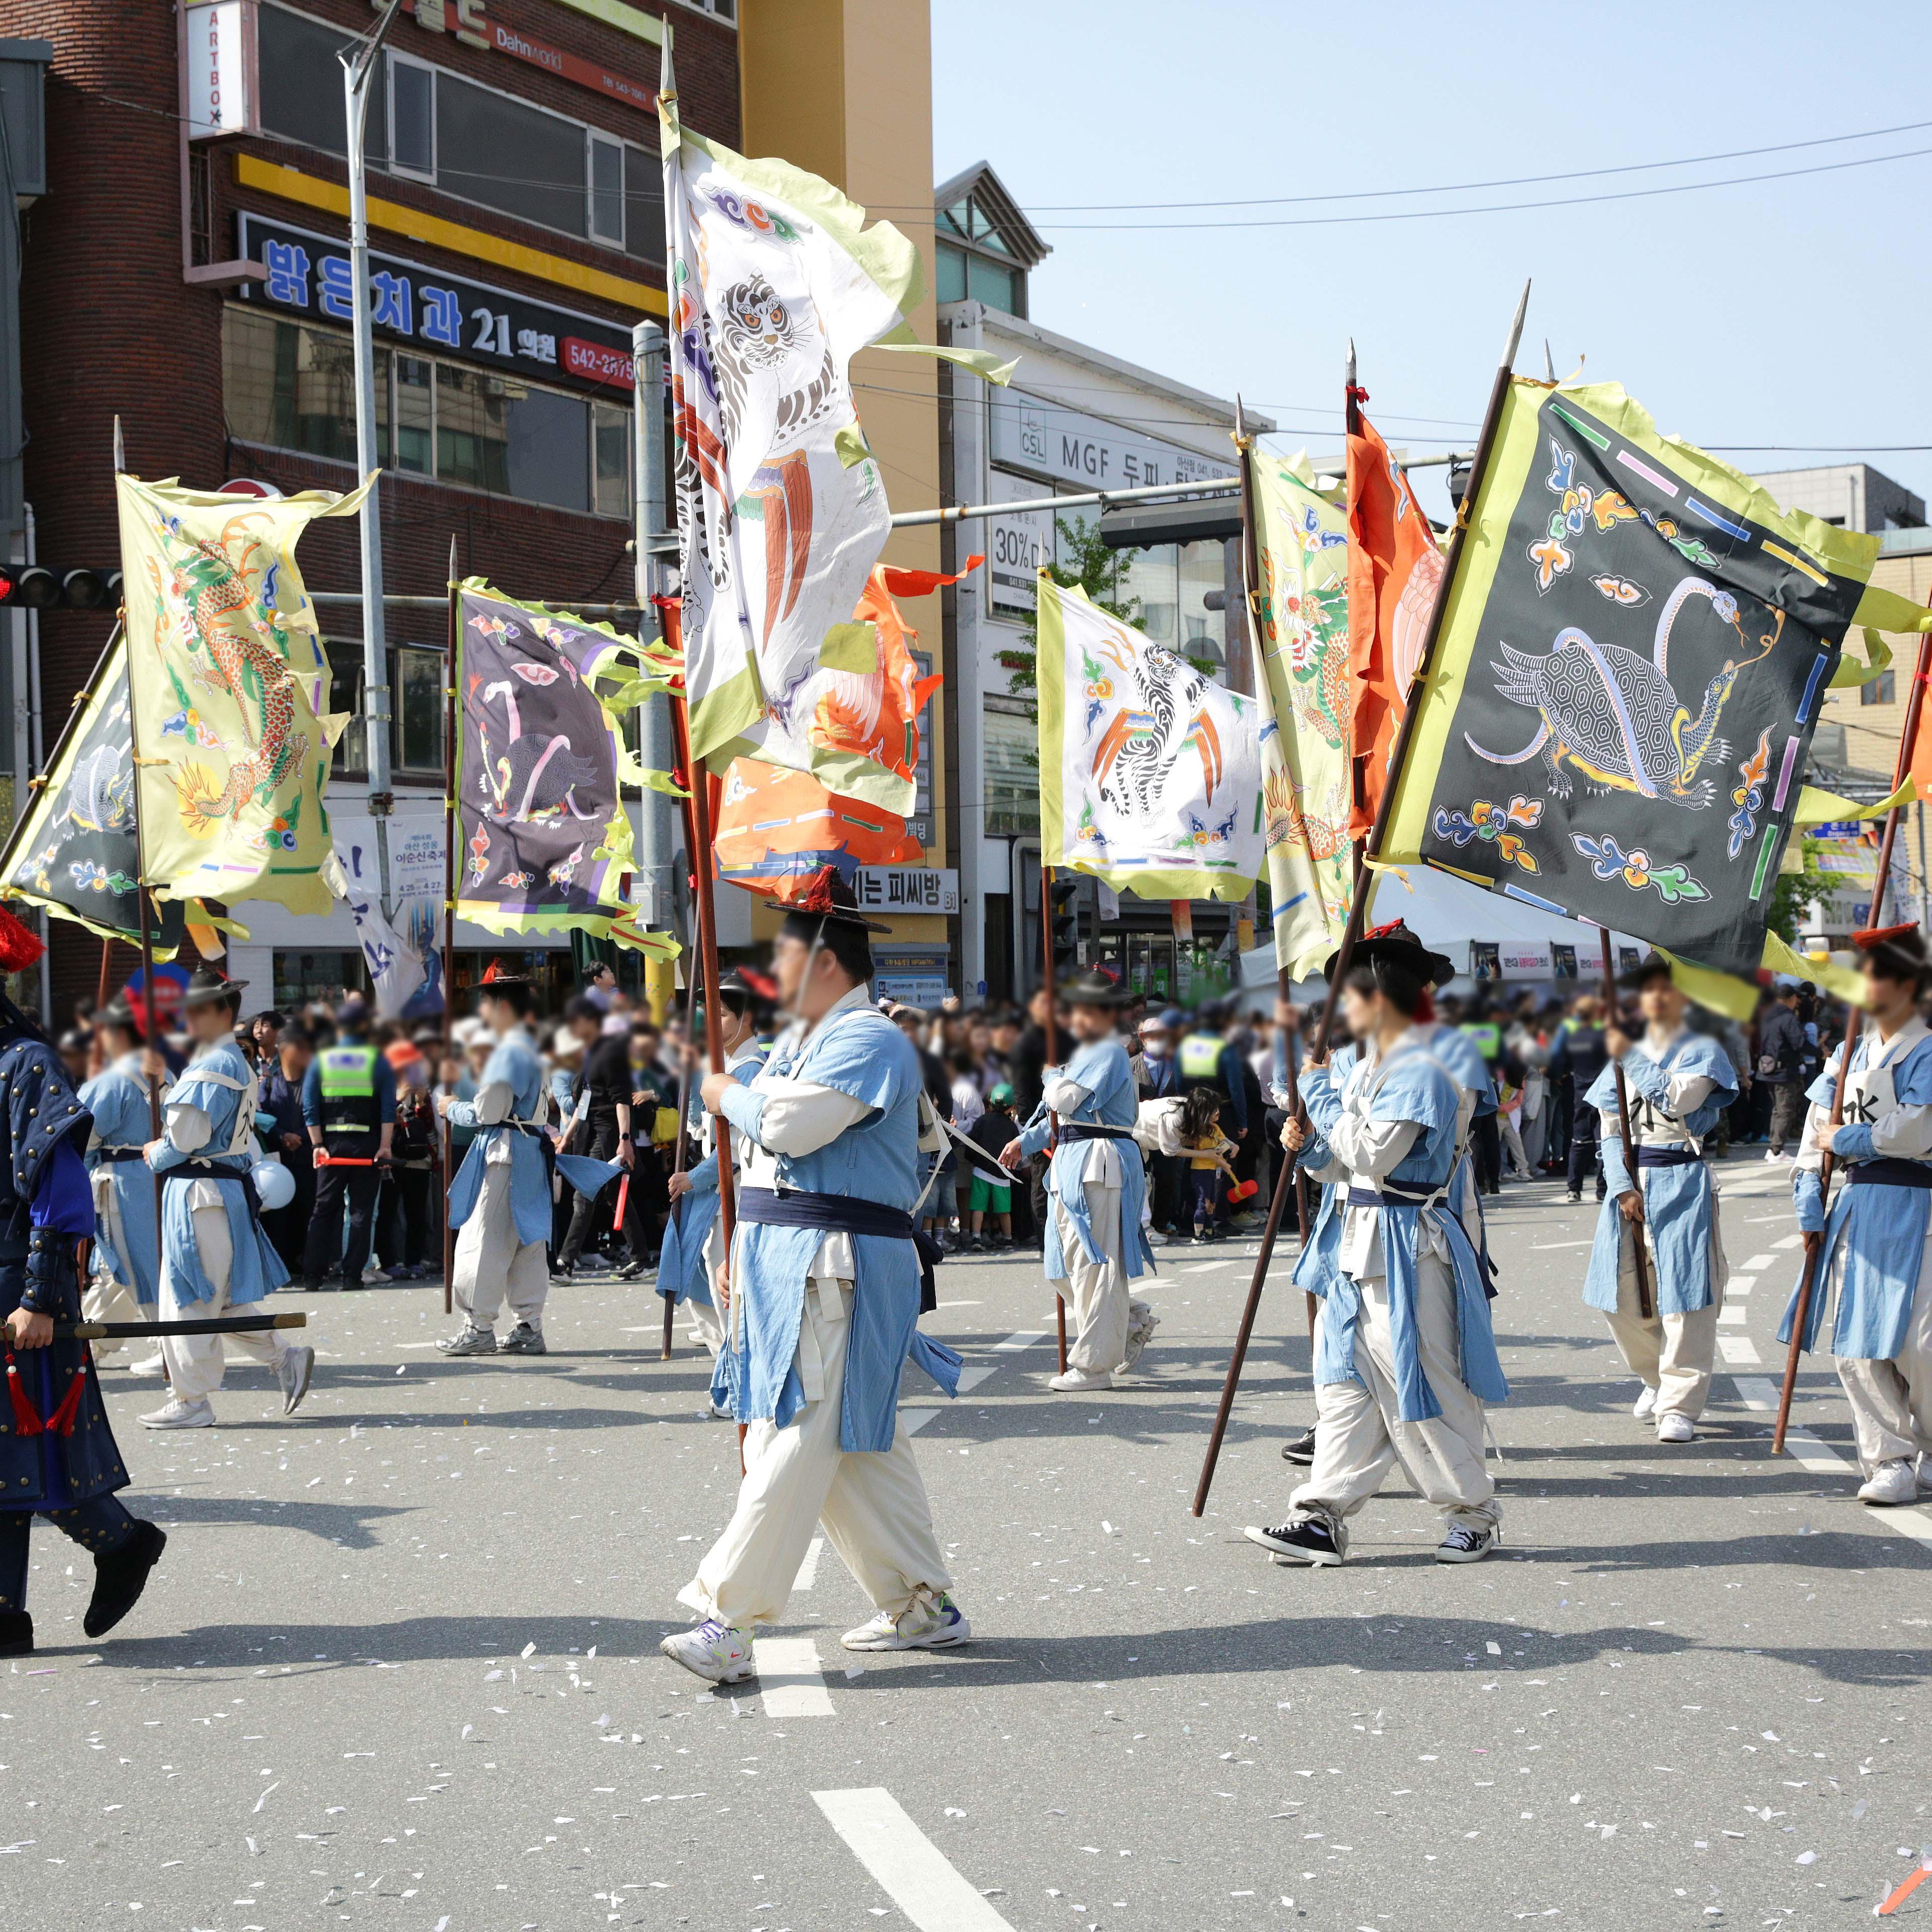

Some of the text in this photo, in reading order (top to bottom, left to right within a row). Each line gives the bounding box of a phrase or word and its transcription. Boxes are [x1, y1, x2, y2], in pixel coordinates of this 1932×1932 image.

[209, 11, 222, 125] ARTBOX
[496, 27, 562, 70] Dahnworld
[262, 239, 463, 348] 밝은치과
[470, 307, 514, 357] 21
[517, 329, 557, 364] 의원
[1022, 433, 1044, 457] CSL
[1063, 435, 1108, 477] MGF
[995, 527, 1029, 569] 30%
[888, 872, 940, 906] 피씨방
[1843, 1087, 1879, 1124] 水
